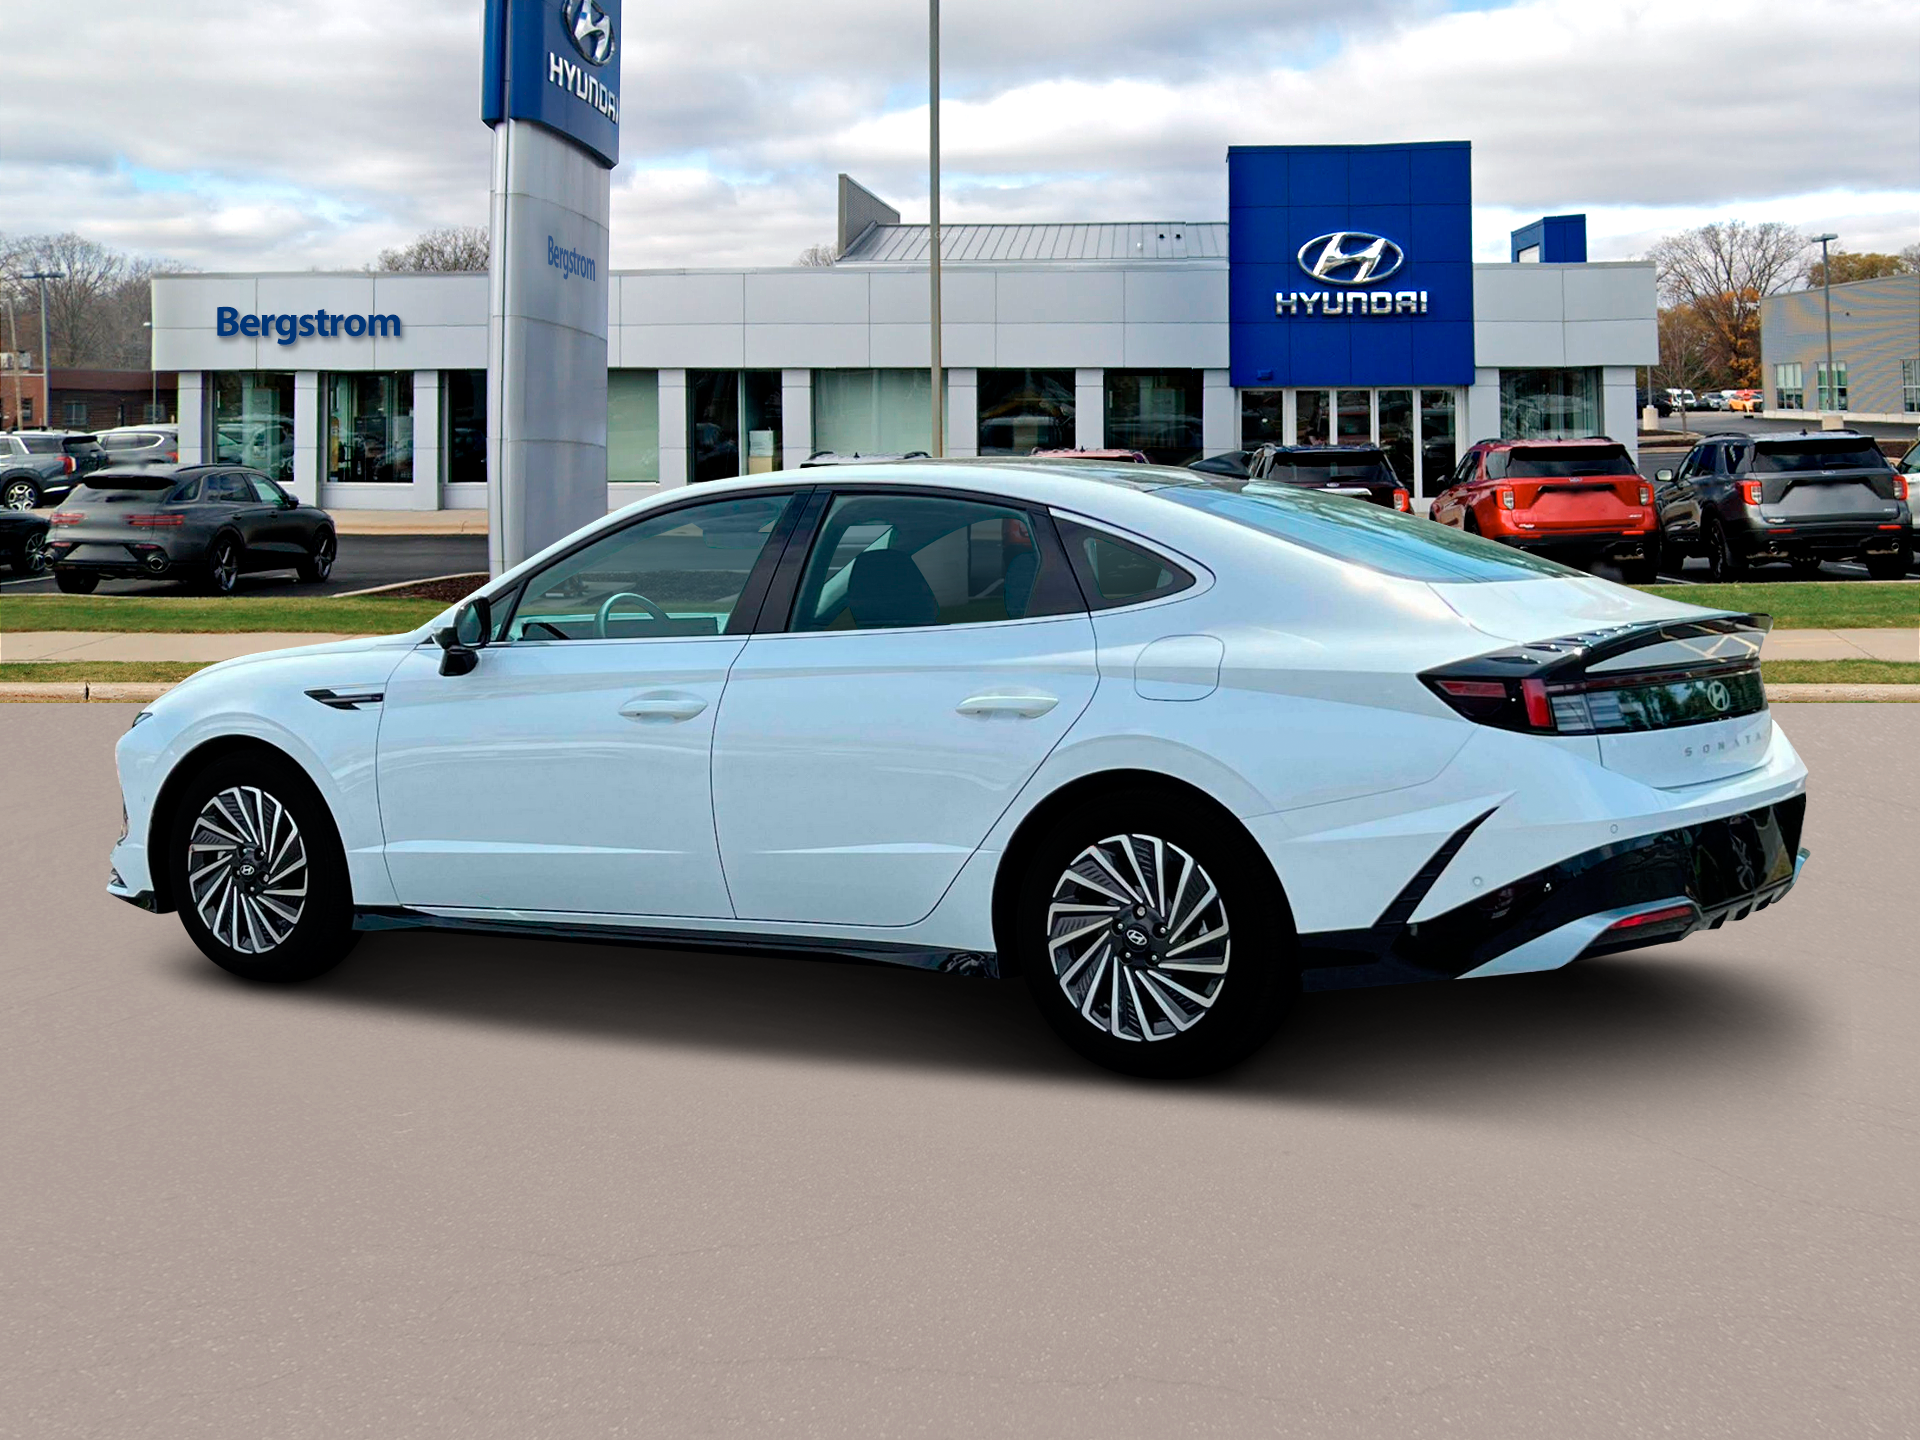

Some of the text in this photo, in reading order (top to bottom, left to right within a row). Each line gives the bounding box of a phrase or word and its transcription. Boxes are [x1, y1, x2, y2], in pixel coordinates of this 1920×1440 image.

[549, 52, 619, 123] HYUNDAI
[547, 235, 596, 281] Bergstrom
[1275, 290, 1428, 315] HYUNDAI
[217, 306, 401, 345] Bergstrom
